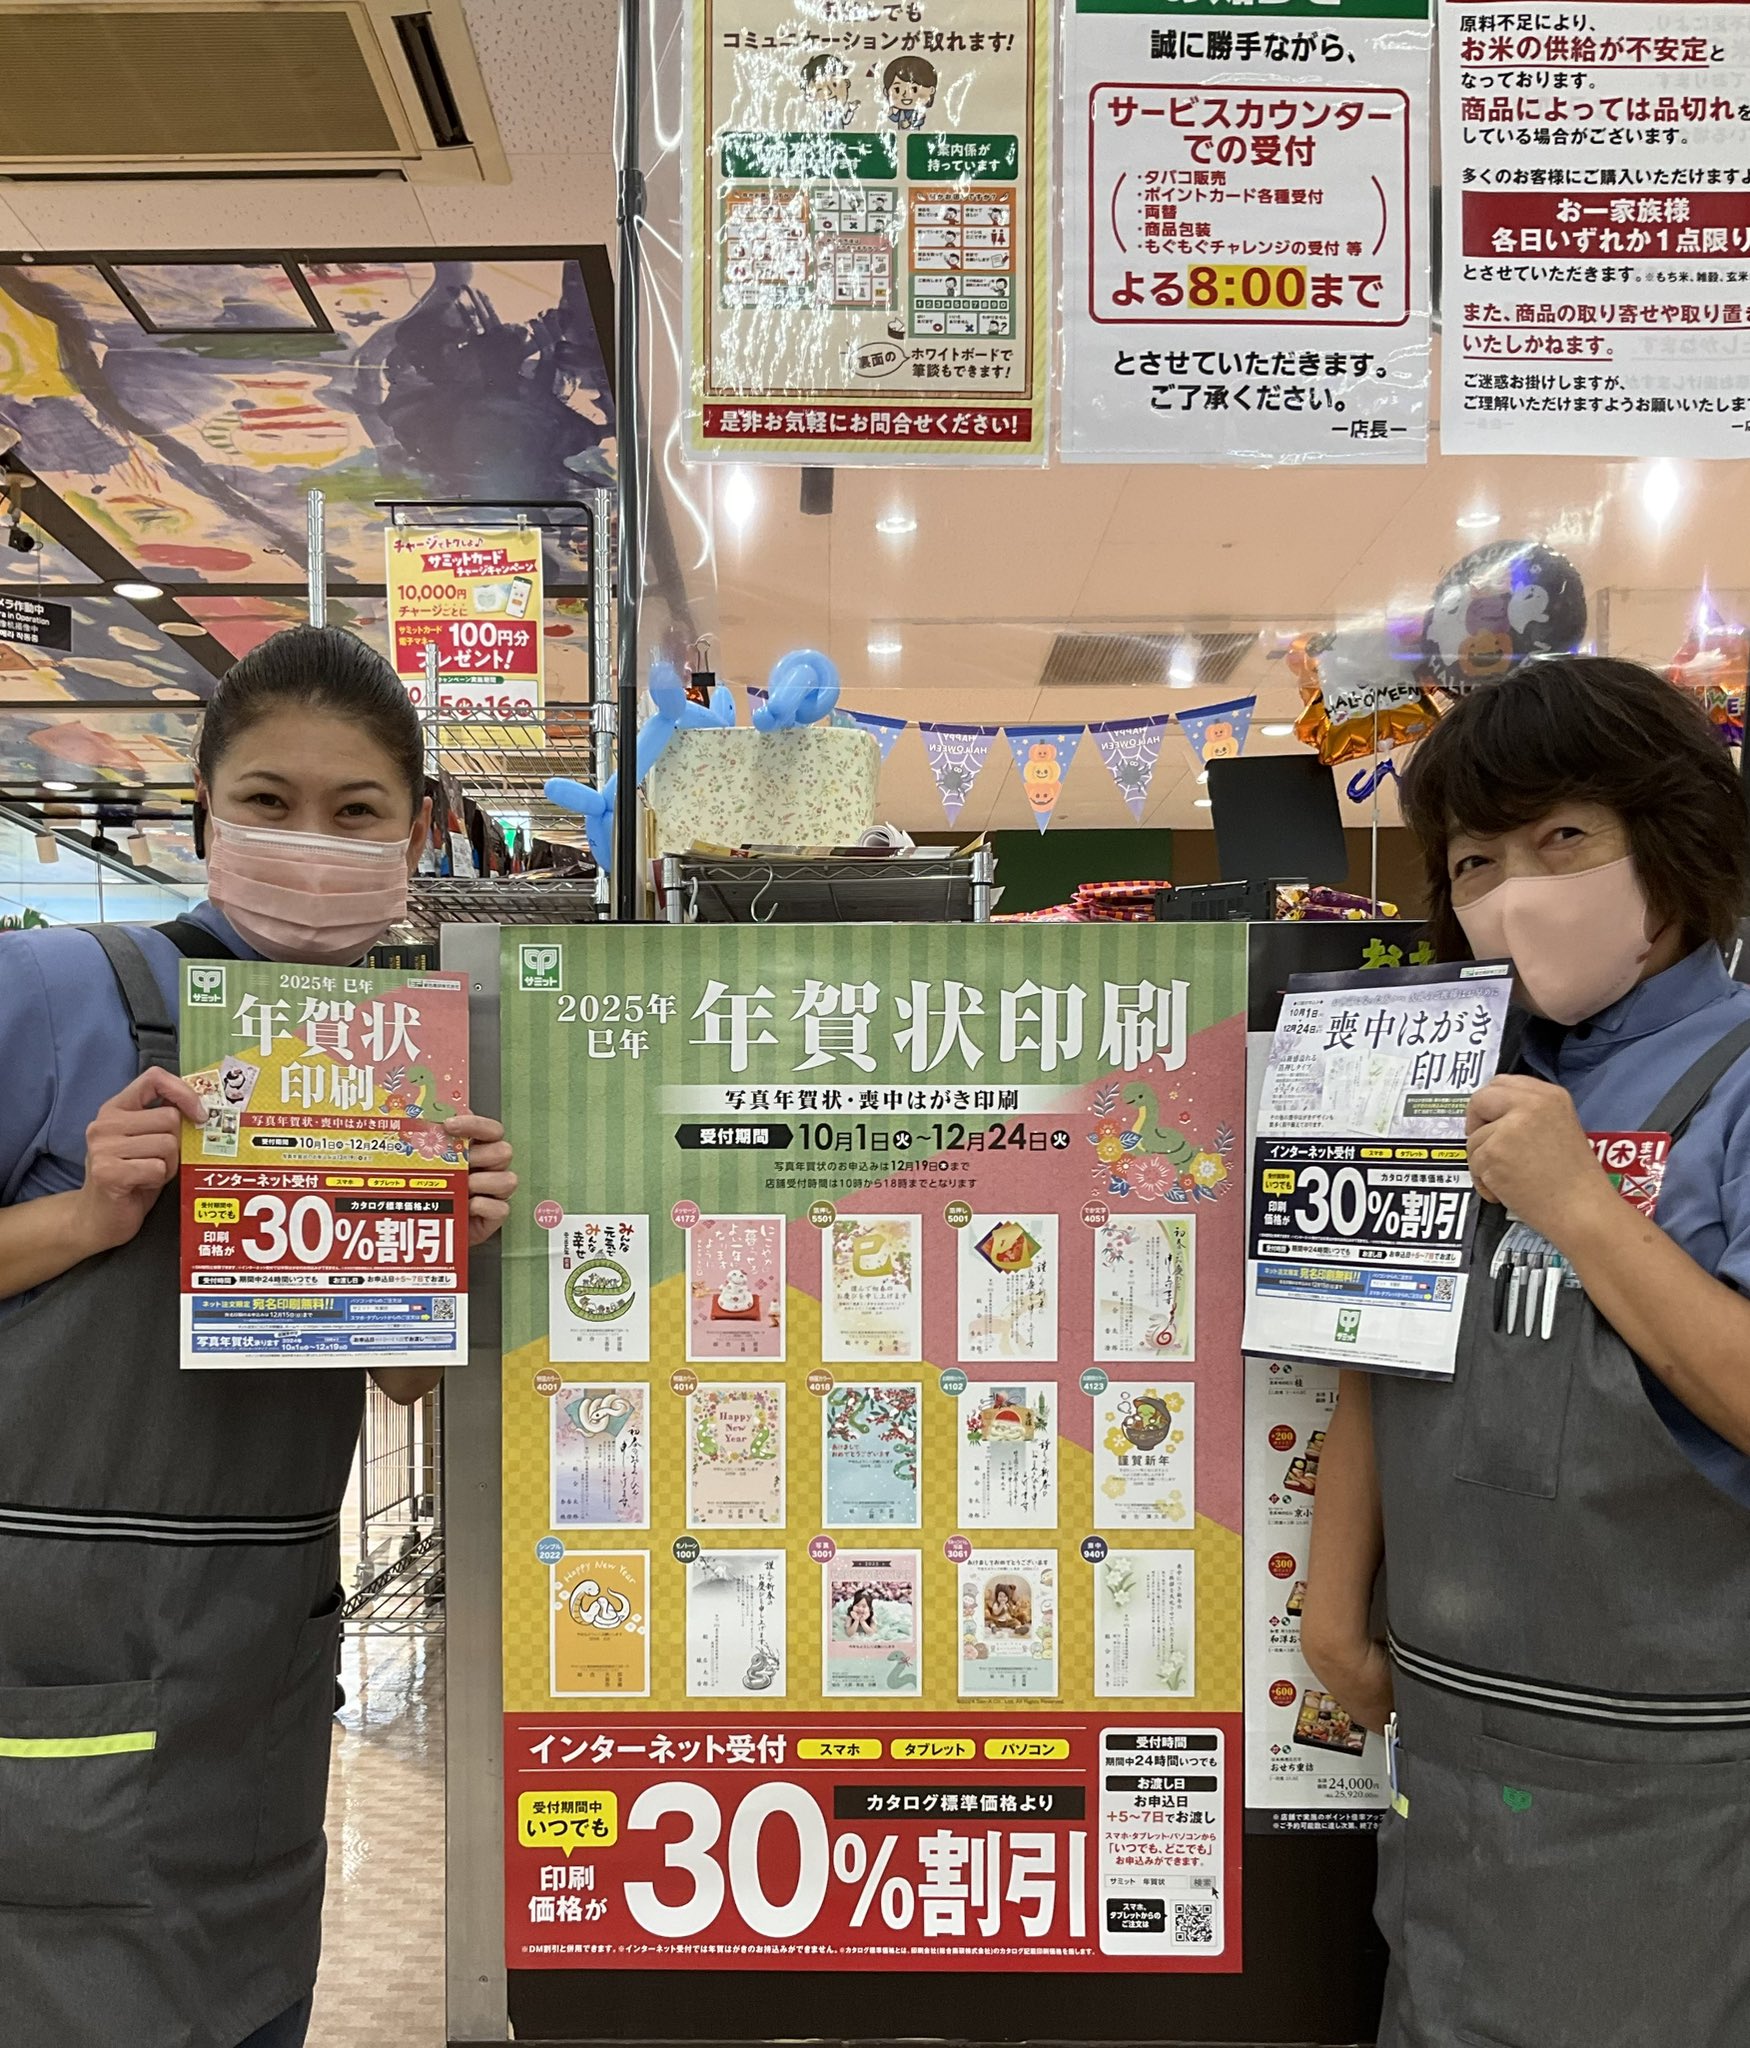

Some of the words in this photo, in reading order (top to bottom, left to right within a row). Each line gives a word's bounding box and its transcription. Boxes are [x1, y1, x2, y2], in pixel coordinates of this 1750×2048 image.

[1460, 14, 1597, 33] 原料不足により、
[1151, 30, 1357, 62] 誠に勝手ながら、
[1461, 37, 1725, 63] お米の供給が不安定と
[1461, 71, 1595, 89] なっております。
[1108, 96, 1392, 131] サービスカウンター
[1463, 127, 1689, 146] している場合がございます。
[1183, 134, 1316, 166] での受付
[928, 158, 1000, 171] 持っています
[1556, 198, 1690, 223] お一家族様
[1463, 265, 1641, 283] とさせていただきます。
[1463, 303, 1750, 324] また、商品の取り寄せや取り置
[1463, 334, 1613, 355] いたしかねます。
[858, 351, 896, 369] 裏面の
[911, 348, 1013, 362] ホワイトボードで
[912, 364, 1011, 378] 筆談もできます!
[1113, 350, 1388, 378] とさせていただきます。
[1464, 374, 1626, 390] ご迷惑お掛けしますが、
[1151, 384, 1345, 413] ご了承ください。
[720, 409, 1018, 435] 是非お気軽にお問合せください!
[428, 551, 504, 568] サミットカード
[457, 563, 534, 577] チャージキャンペーン
[398, 585, 467, 602] 10,000円
[399, 606, 467, 617] チャージごとに
[16, 614, 50, 625] Operation
[449, 622, 530, 647] 100円分
[280, 974, 336, 992] 2025年
[524, 977, 557, 986] サミット
[193, 993, 221, 1002] サミット
[557, 994, 677, 1024] 2025年
[231, 992, 421, 1062] 年賀状
[689, 979, 1191, 1073] 年賀状印刷
[1323, 1004, 1493, 1050] 喪中はがき
[1410, 1050, 1487, 1090] 印刷
[280, 1061, 375, 1111] 印刷
[725, 1089, 1019, 1110] 写真年賀状・喪中はがき印刷
[700, 1129, 769, 1145] 受付期間
[1270, 1146, 1354, 1160] インターネット受付
[203, 1173, 318, 1188] インターネット受付
[1265, 1180, 1292, 1190] いつでも
[1381, 1173, 1460, 1183] カタログ標準価格より
[351, 1201, 439, 1211] カタログ標準価格より
[1268, 1200, 1287, 1213] 印刷
[1294, 1166, 1471, 1240] 30%割引
[198, 1209, 236, 1219] いつでも
[538, 1215, 558, 1223] 4171
[675, 1215, 696, 1223] 4172
[812, 1215, 832, 1223] 5501
[948, 1215, 968, 1223] 5001
[1084, 1215, 1105, 1223] 4051
[1264, 1214, 1290, 1226] 価格が
[242, 1194, 454, 1264] 30%割引
[203, 1231, 229, 1243] 印刷
[198, 1244, 235, 1257] 価格が
[537, 1383, 558, 1391] 4001
[673, 1383, 695, 1391] 4014
[943, 1383, 964, 1391] 4102
[1083, 1383, 1104, 1391] 4123
[719, 1411, 752, 1424] Happy
[726, 1423, 746, 1432] New
[726, 1434, 748, 1443] Year
[1118, 1455, 1170, 1466] 謹賀新年
[539, 1551, 561, 1559] 2022
[812, 1550, 833, 1558] 3001
[947, 1550, 969, 1559] 3061
[1084, 1550, 1105, 1558] 9401
[564, 1561, 591, 1583] Happy
[594, 1560, 616, 1571] New
[618, 1565, 636, 1585] Year
[529, 1734, 787, 1764] インターネット受付
[820, 1743, 860, 1756] スマホ
[905, 1743, 966, 1757] タブレット
[1001, 1743, 1055, 1757] パソコン
[1136, 1736, 1187, 1749] 受付時間
[1105, 1755, 1217, 1767] 期間中24時間いつでも
[1137, 1778, 1186, 1790] お渡し日
[532, 1801, 602, 1814] 受付期間中
[867, 1794, 1054, 1813] カタログ標準価格より
[1134, 1795, 1188, 1808] お申込日
[527, 1818, 609, 1838] いつでも
[1109, 1843, 1212, 1855] 「いつでも、どこでも」
[624, 1781, 1086, 1938] 30%割引
[1115, 1856, 1204, 1866] お申込みができます。
[540, 1865, 594, 1891] 印刷
[1110, 1878, 1136, 1886] サミット
[1143, 1878, 1166, 1886] 年賀状
[528, 1896, 607, 1923] 価格が
[1110, 1911, 1161, 1919] タブレットからの
[1121, 1919, 1150, 1928] ご注文は
